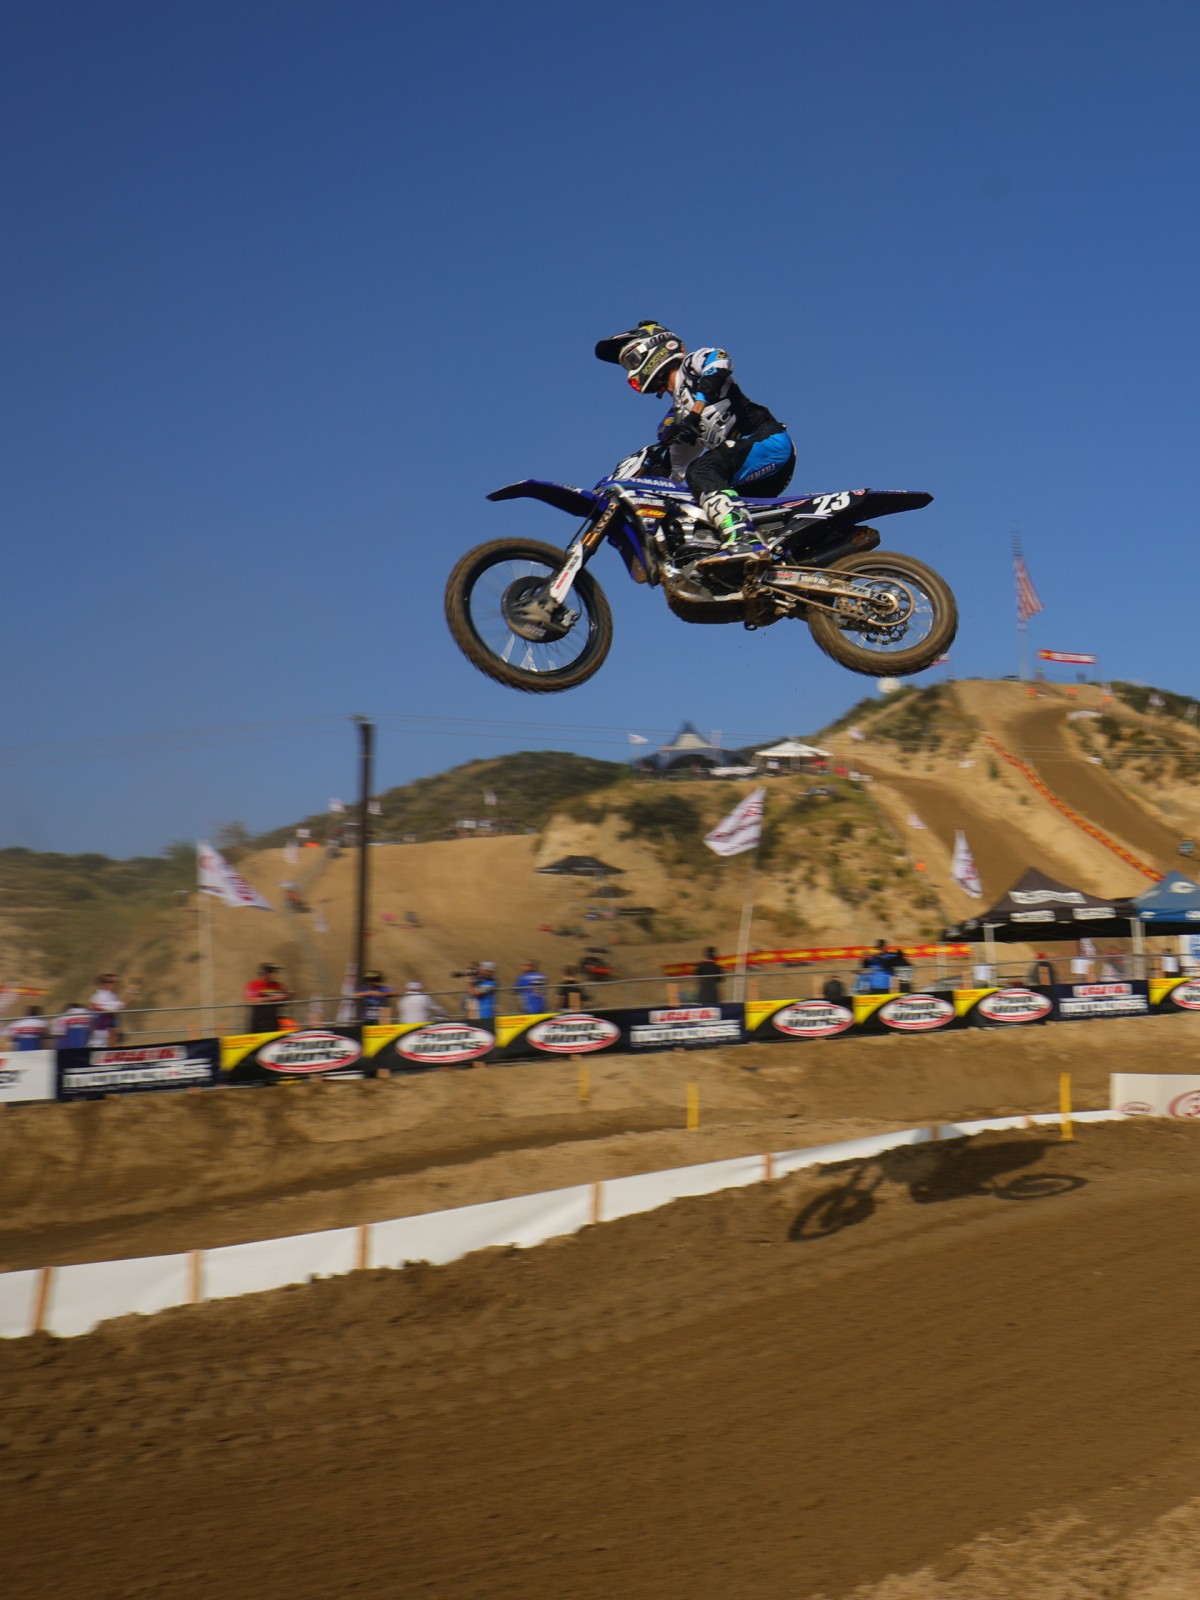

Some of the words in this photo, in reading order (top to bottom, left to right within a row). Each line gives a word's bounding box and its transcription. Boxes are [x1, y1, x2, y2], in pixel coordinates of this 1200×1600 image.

[744, 463, 776, 482] YAMAHA
[630, 477, 677, 489] YAMAHA
[812, 491, 851, 515] 23
